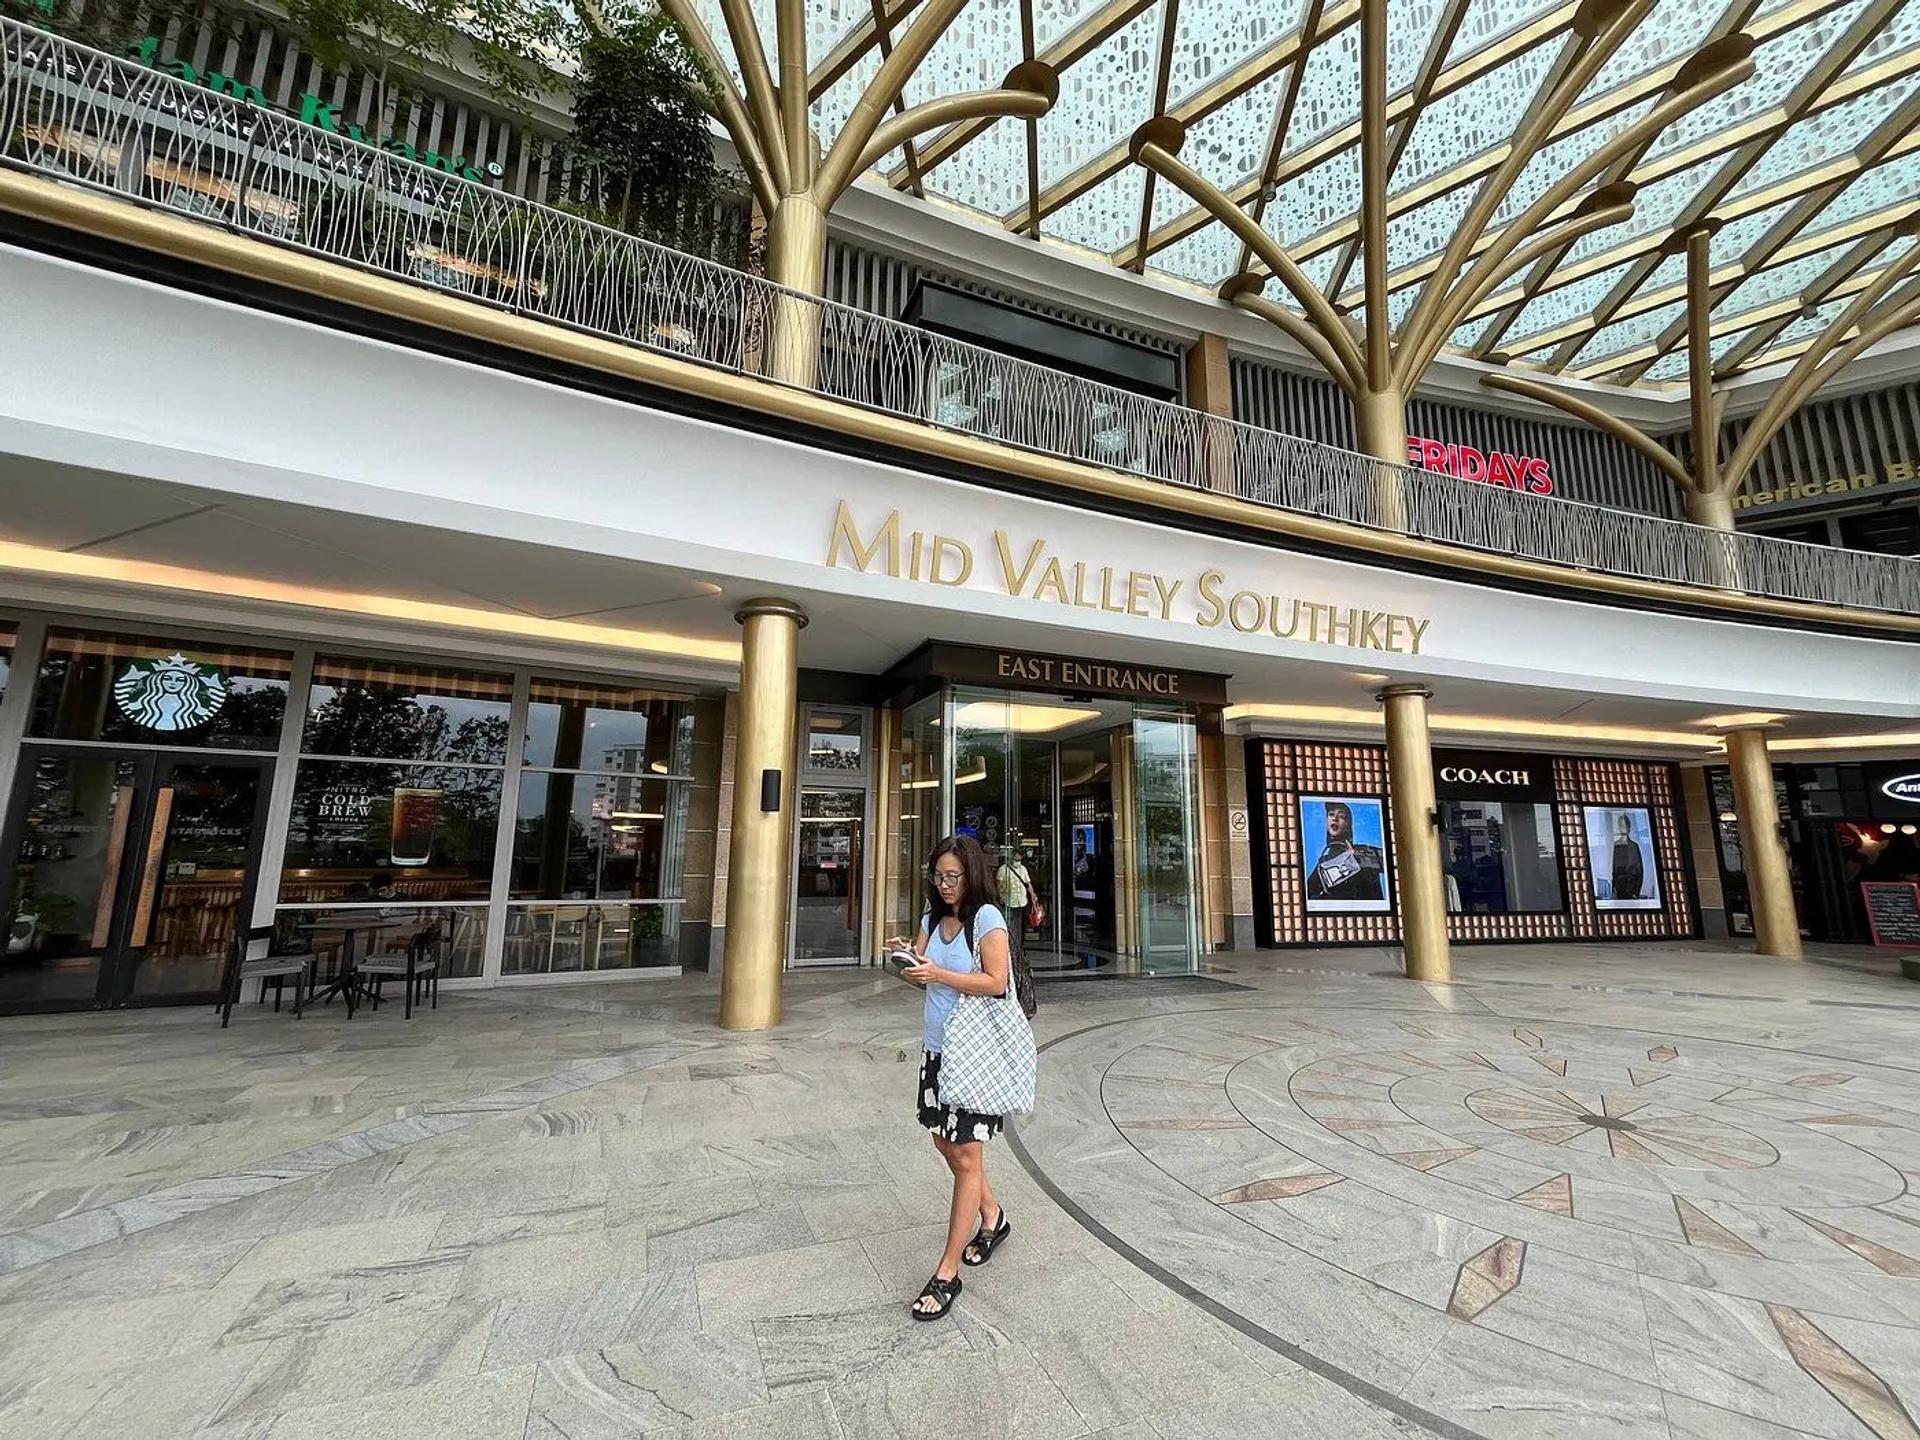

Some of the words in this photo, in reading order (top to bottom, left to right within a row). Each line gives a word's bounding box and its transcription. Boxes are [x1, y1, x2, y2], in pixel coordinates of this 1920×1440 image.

[1887, 463, 1920, 481] B
[998, 654, 1054, 681] EAST
[1062, 662, 1179, 694] ENTRANCE
[1440, 767, 1530, 786] COACH
[322, 793, 371, 805] COLD
[318, 804, 373, 816] BREW
